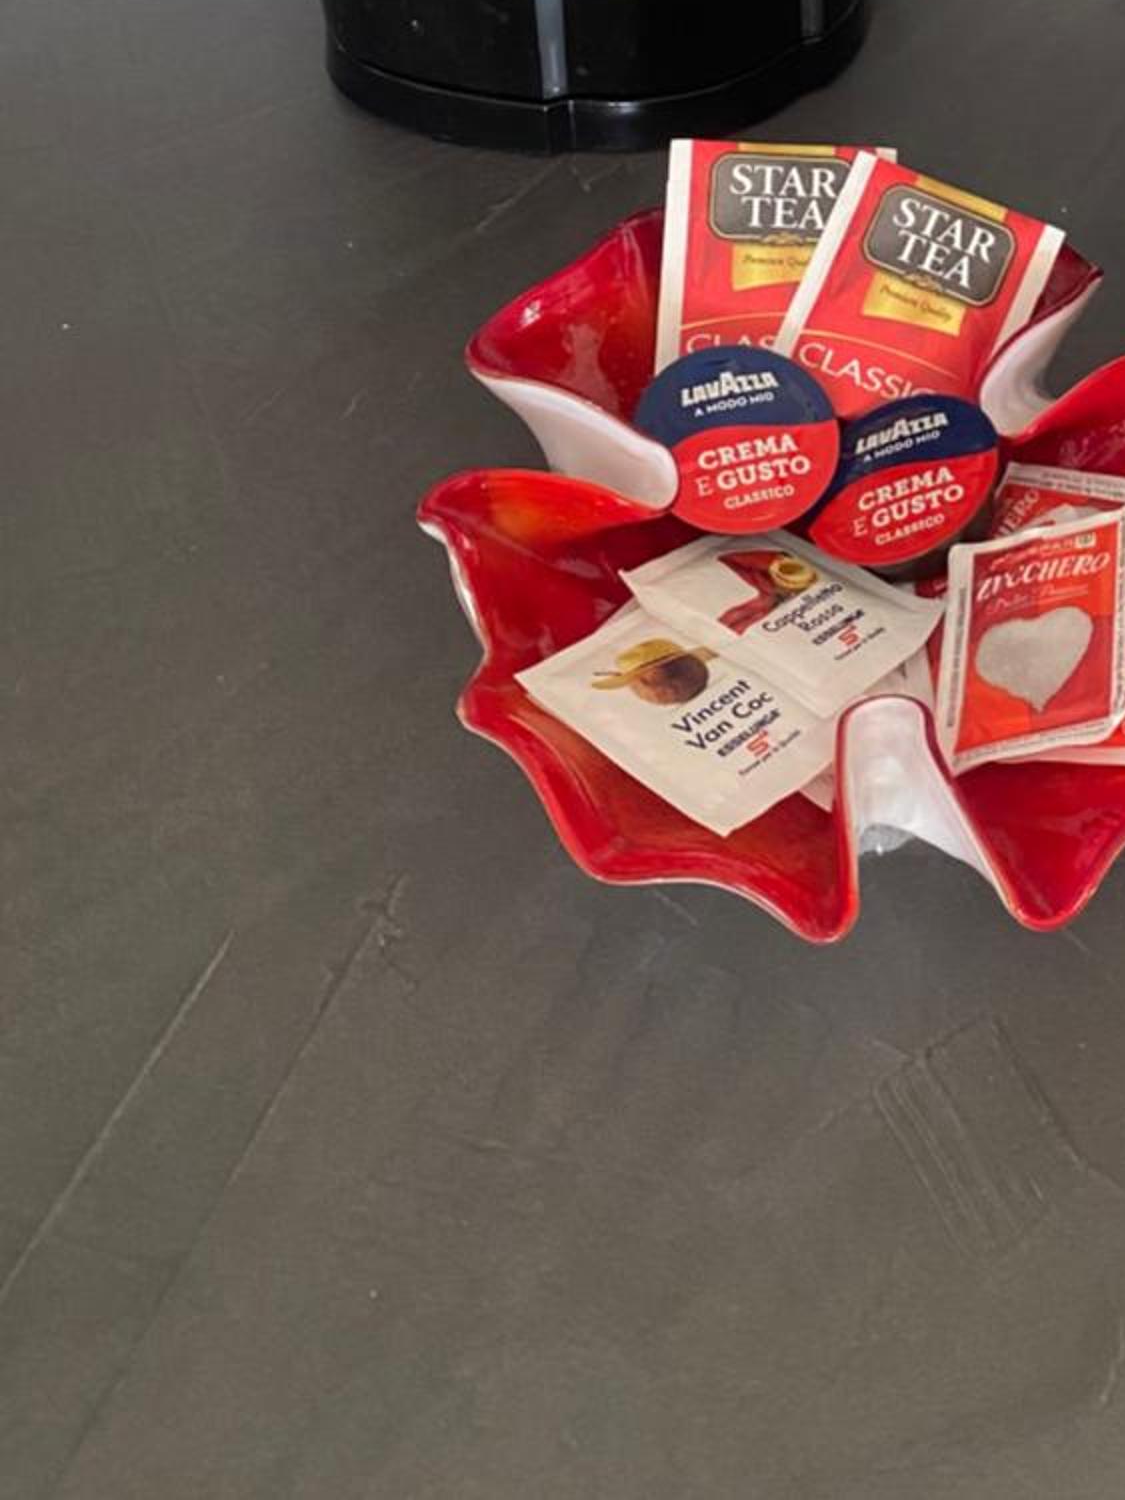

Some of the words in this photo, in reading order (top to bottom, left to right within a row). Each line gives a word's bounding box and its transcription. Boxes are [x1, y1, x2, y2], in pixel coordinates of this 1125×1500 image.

[729, 164, 836, 198] STAR
[741, 196, 824, 229] TEA
[893, 198, 995, 263] STAR
[898, 229, 970, 289] TEA
[681, 372, 779, 407] LAVAZZA
[694, 407, 704, 417] A
[706, 396, 747, 413] MODO
[749, 392, 775, 404] MIO
[698, 433, 799, 470] CREMA
[855, 412, 948, 455] LAVAZZA
[864, 453, 873, 462] A
[874, 438, 913, 459] MODO
[916, 430, 940, 443] MIO
[695, 475, 714, 497] E
[717, 455, 811, 490] GUSTO
[858, 466, 955, 511] CREMA
[723, 484, 795, 509] CLASSICO
[853, 516, 868, 537] E
[872, 484, 964, 528] GUSTO
[875, 513, 945, 546] CLASSICO
[671, 679, 751, 733] Vincent
[685, 720, 734, 750] Van
[732, 692, 774, 719] Coc
